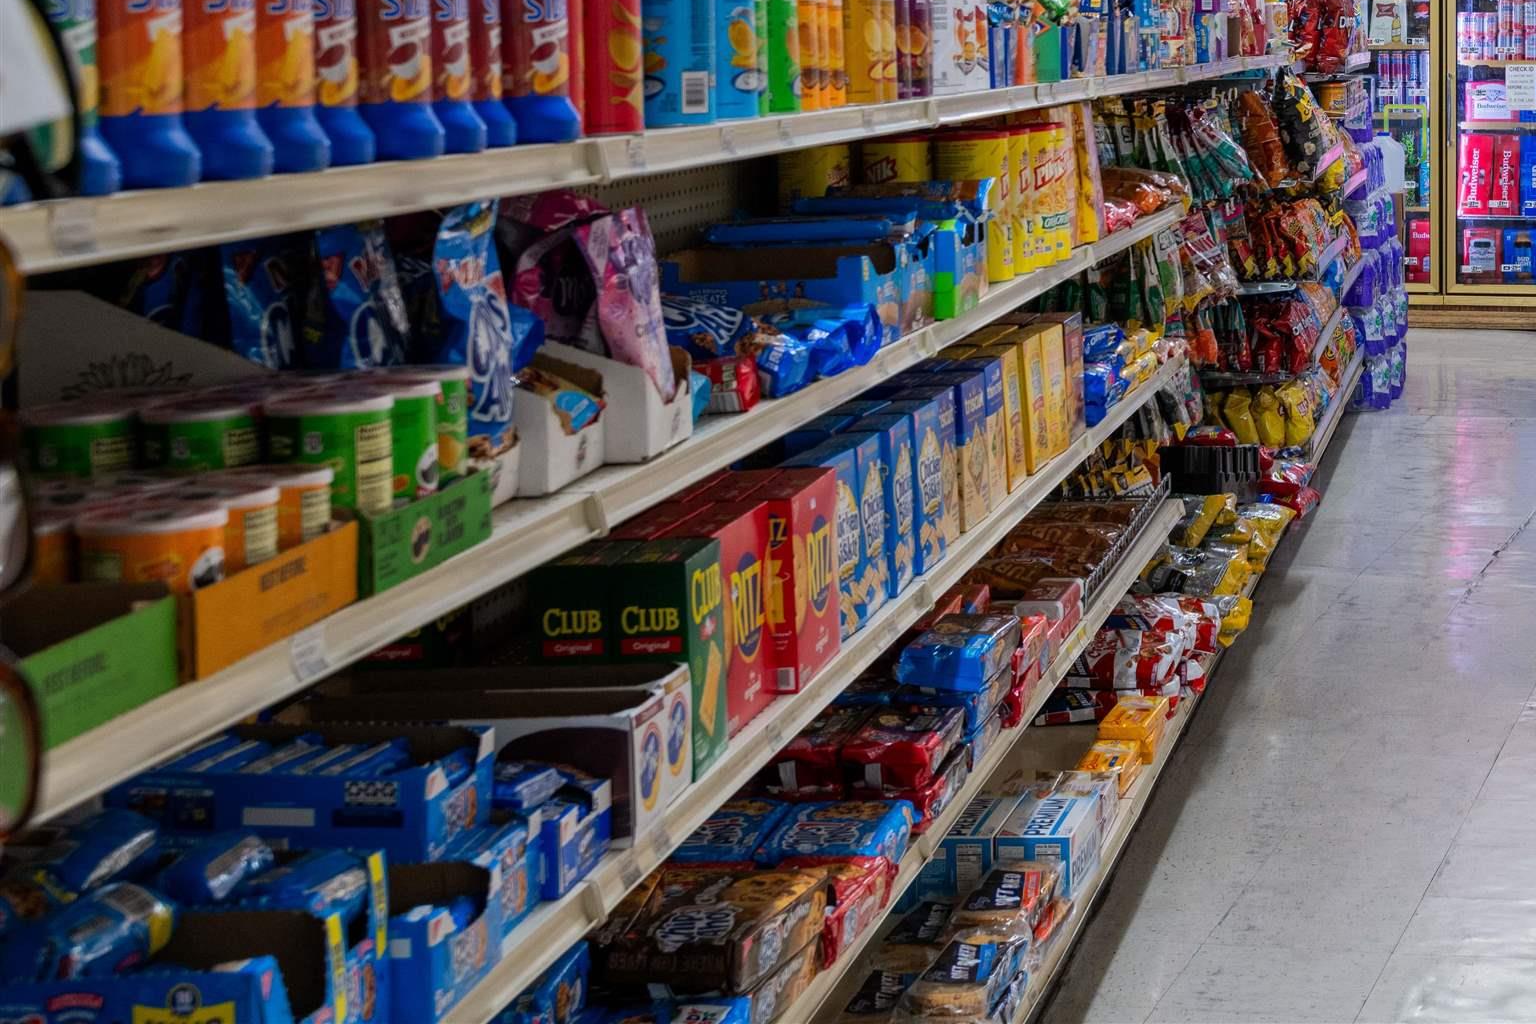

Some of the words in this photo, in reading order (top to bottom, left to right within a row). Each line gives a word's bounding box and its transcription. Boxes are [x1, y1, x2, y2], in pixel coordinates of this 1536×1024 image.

[1467, 148, 1480, 203] Budweiser
[1502, 150, 1512, 201] Budweiser
[690, 294, 728, 304] TREATS
[806, 521, 834, 601] RITZ
[691, 561, 723, 625] CLUB
[730, 559, 765, 646] RITZ
[543, 607, 602, 637] CLUB
[621, 605, 680, 635] CLUB
[632, 639, 671, 652] Original
[950, 798, 996, 836] PREMIUM
[1024, 798, 1069, 836] PREMIUM
[1071, 830, 1098, 885] PREMIUM
